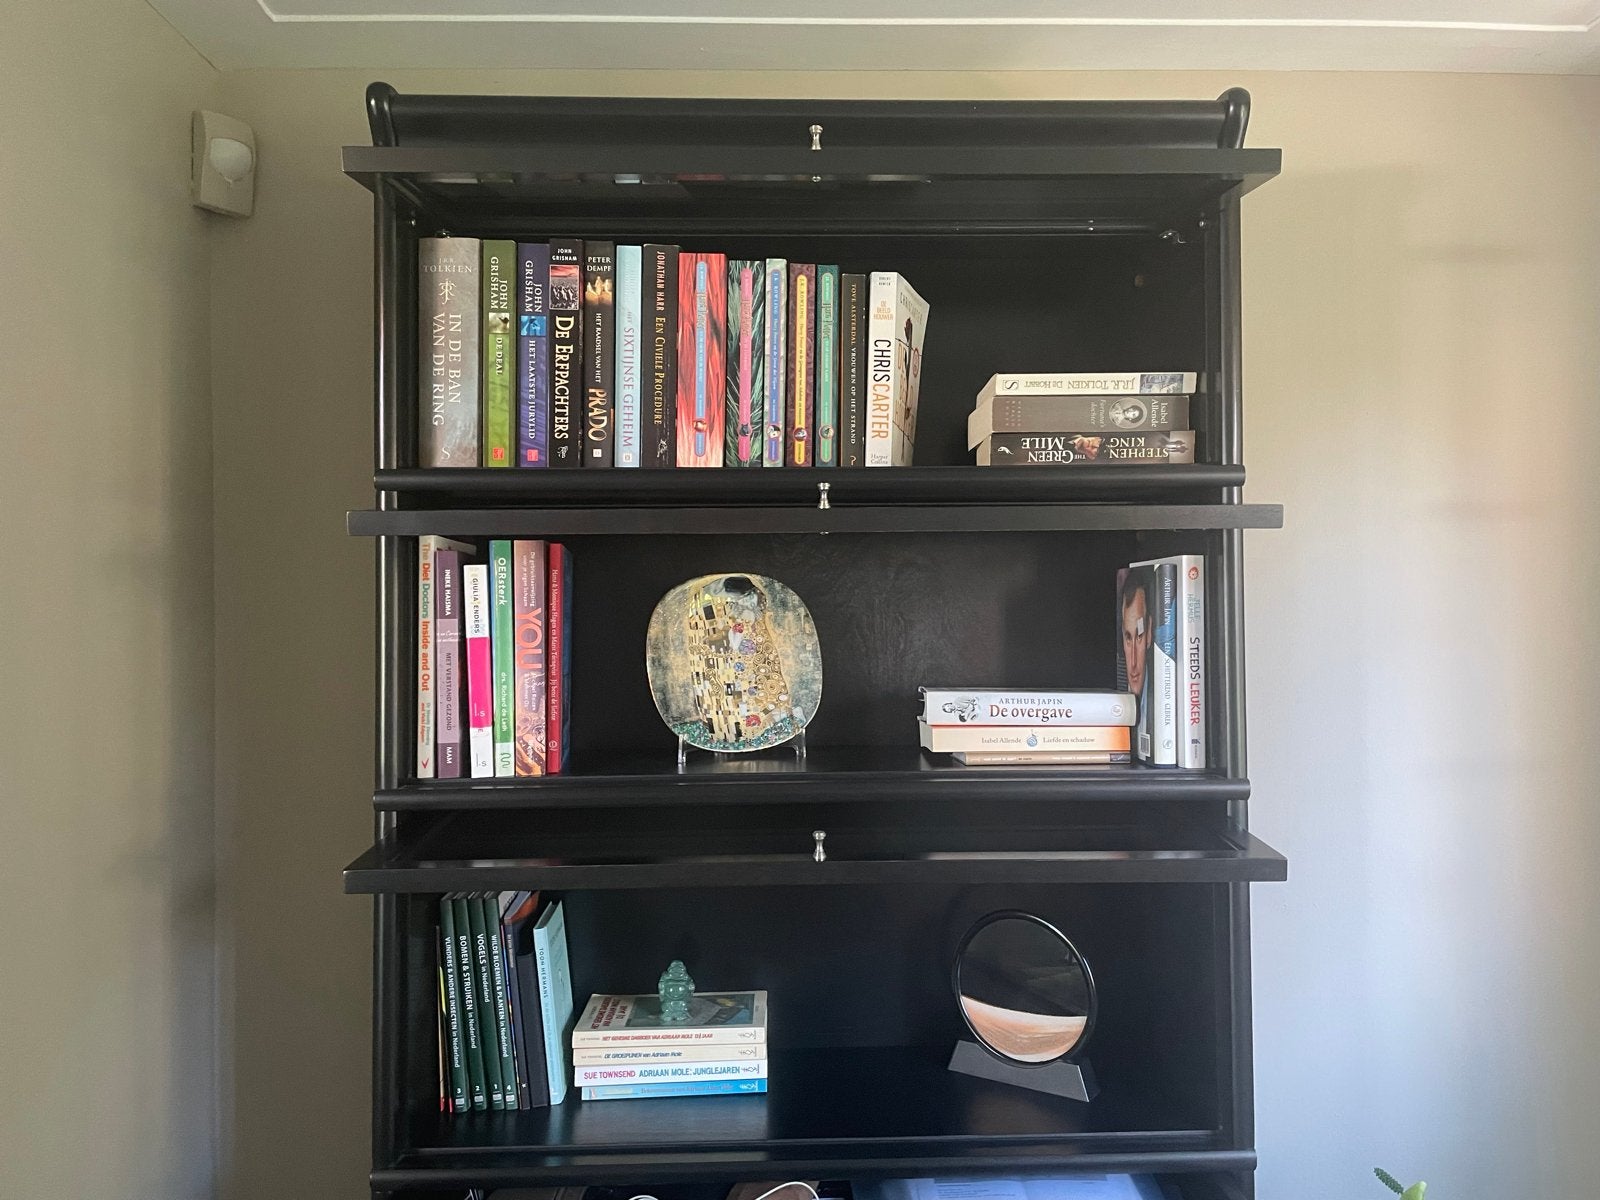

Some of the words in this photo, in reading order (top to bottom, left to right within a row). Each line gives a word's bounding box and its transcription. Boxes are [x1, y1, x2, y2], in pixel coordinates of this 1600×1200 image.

[423, 264, 472, 273] TOLKIEN
[587, 256, 613, 264] PETER
[656, 251, 665, 289] JONATHAN
[490, 256, 500, 309] GRISHAM
[499, 279, 508, 309] JOHN
[525, 260, 534, 313] GRISHAM
[534, 283, 543, 313] JOHN
[656, 291, 665, 311] HARR
[432, 313, 445, 349] VAN
[449, 313, 461, 332] IN
[594, 313, 602, 326] HET
[655, 316, 666, 335] EEN
[449, 339, 461, 362] DE
[495, 337, 504, 351] DE
[528, 340, 536, 358] HET
[594, 327, 602, 354] RAADSEL
[655, 336, 666, 370] CIVIELE
[432, 352, 445, 377] DE
[495, 355, 504, 376] DEAL
[594, 355, 602, 369] VAN
[622, 327, 635, 391] SIXTIJNSE
[449, 369, 461, 403] BAN
[528, 361, 536, 400] LAATSTE
[594, 370, 602, 384] HET
[1067, 379, 1110, 390] TOLKIEN
[432, 383, 445, 426] RING
[554, 343, 574, 439] ERFPACHTERS
[654, 372, 665, 425] PROCEDURE
[850, 386, 857, 396] OP
[527, 400, 536, 439] JURYLID
[587, 388, 608, 442] PRADO
[622, 394, 634, 448] GEHEIM
[1150, 398, 1160, 428] Allende
[1159, 402, 1169, 424] Isabel
[1021, 436, 1067, 450] MILE
[1108, 447, 1169, 459] STEPHEN
[1110, 436, 1146, 447] KING
[1027, 450, 1074, 464] GREEN
[422, 543, 431, 561] The
[422, 562, 431, 581] Diet
[498, 557, 508, 606] OERsterk
[422, 583, 431, 619] Doctors
[444, 589, 452, 616] HAISMA
[550, 589, 558, 612] Monique
[1164, 577, 1172, 604] ARTHUR
[550, 612, 558, 629] Hagen
[1164, 608, 1172, 625] JAPIN
[1186, 593, 1195, 624] HERMUS
[422, 621, 431, 649] Inside
[516, 607, 543, 669] YOU
[1164, 642, 1172, 654] EEN
[422, 652, 431, 671] and
[1189, 636, 1201, 680] STEEDS
[422, 673, 431, 692] Out
[501, 672, 509, 683] drs.
[1164, 657, 1172, 700] SCHITTEREND
[500, 685, 509, 707] Richard
[998, 698, 1036, 706] ARTHUR
[1036, 698, 1063, 707] JAPIN
[1189, 682, 1201, 726] LEUKER
[500, 708, 508, 717] de
[989, 704, 1007, 718] De
[1011, 706, 1073, 722] overgave
[1164, 703, 1172, 726] GEBREK
[980, 736, 999, 744] Isabel
[999, 736, 1022, 744] Allende
[1042, 736, 1061, 744] Liefde
[1070, 736, 1095, 744] schaduw
[444, 936, 453, 967] VLINDERS
[459, 935, 468, 964] BOMEN
[477, 933, 487, 964] VOGELS
[493, 955, 502, 985] BLOEMEN
[540, 967, 549, 999] HERMANS
[447, 973, 455, 998] ANDERE
[463, 972, 473, 1010] STRUIKEN
[481, 972, 490, 1003] Nederland
[449, 999, 458, 1030] INSECTEN
[497, 991, 505, 1020] PLANTEN
[468, 1018, 477, 1049] Nederland
[500, 1027, 509, 1058] Nederland
[452, 1037, 461, 1068] Nederland
[584, 1071, 598, 1080] SUE
[599, 1070, 636, 1079] TOWNSEND
[638, 1069, 670, 1078] ADRIAAN
[671, 1067, 692, 1076] MOLE:
[692, 1066, 741, 1076] JUNGLEJAREN
